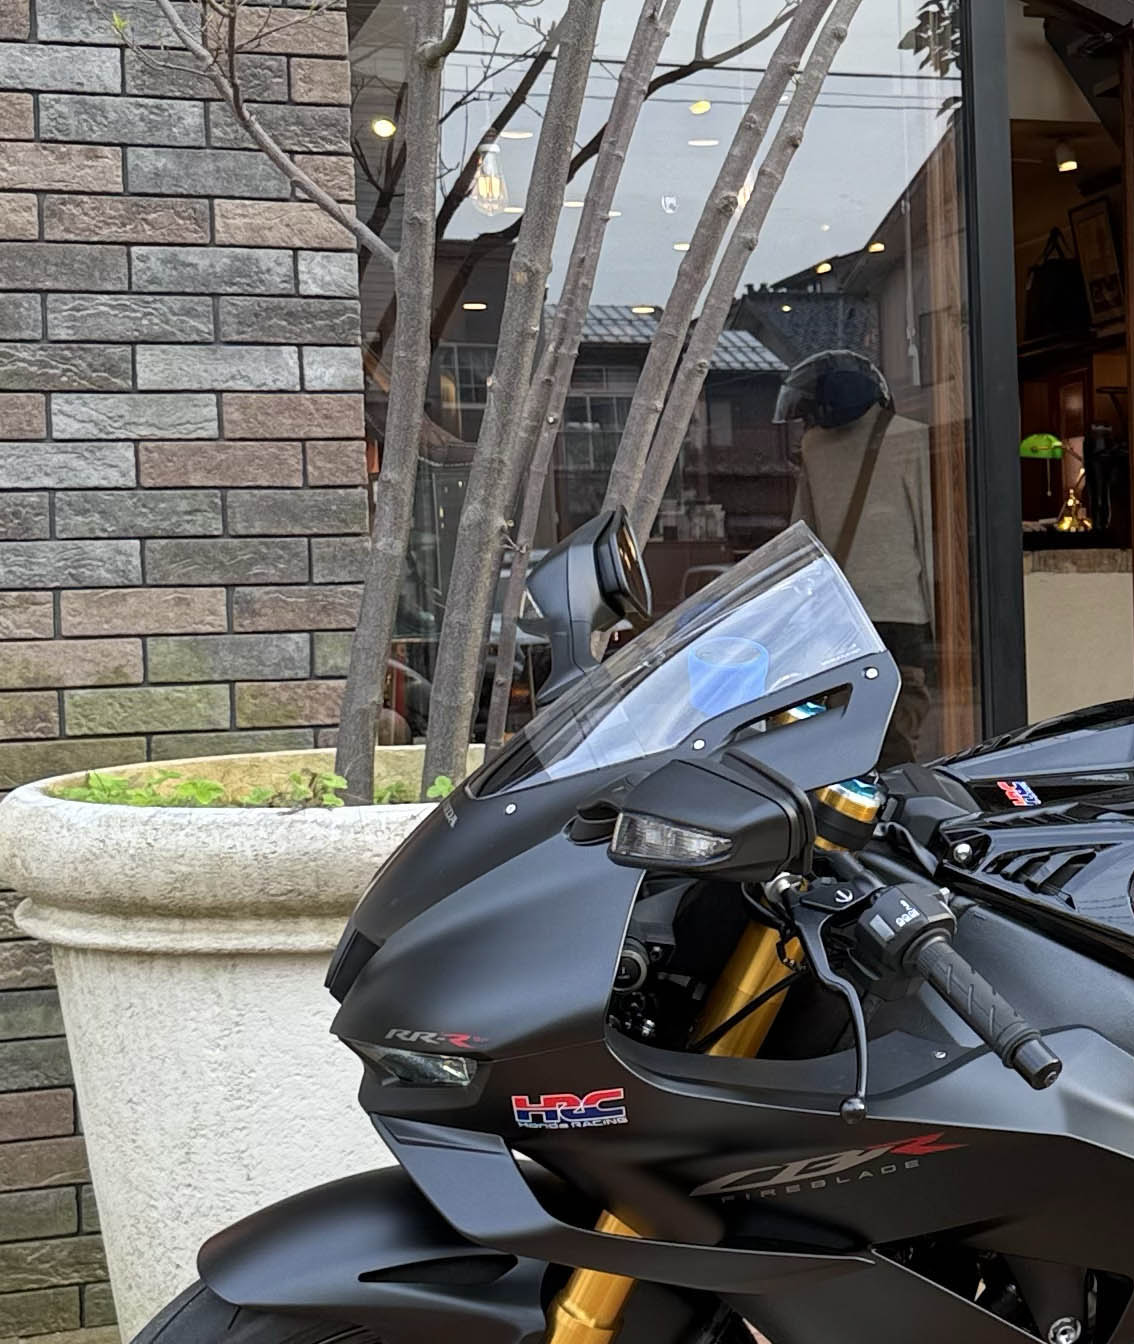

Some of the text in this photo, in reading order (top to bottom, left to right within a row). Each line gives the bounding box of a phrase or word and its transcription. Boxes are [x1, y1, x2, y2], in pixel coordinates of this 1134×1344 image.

[511, 1088, 627, 1123] HRC
[570, 1116, 629, 1129] RACING
[721, 1159, 920, 1204] FIREBLADE
